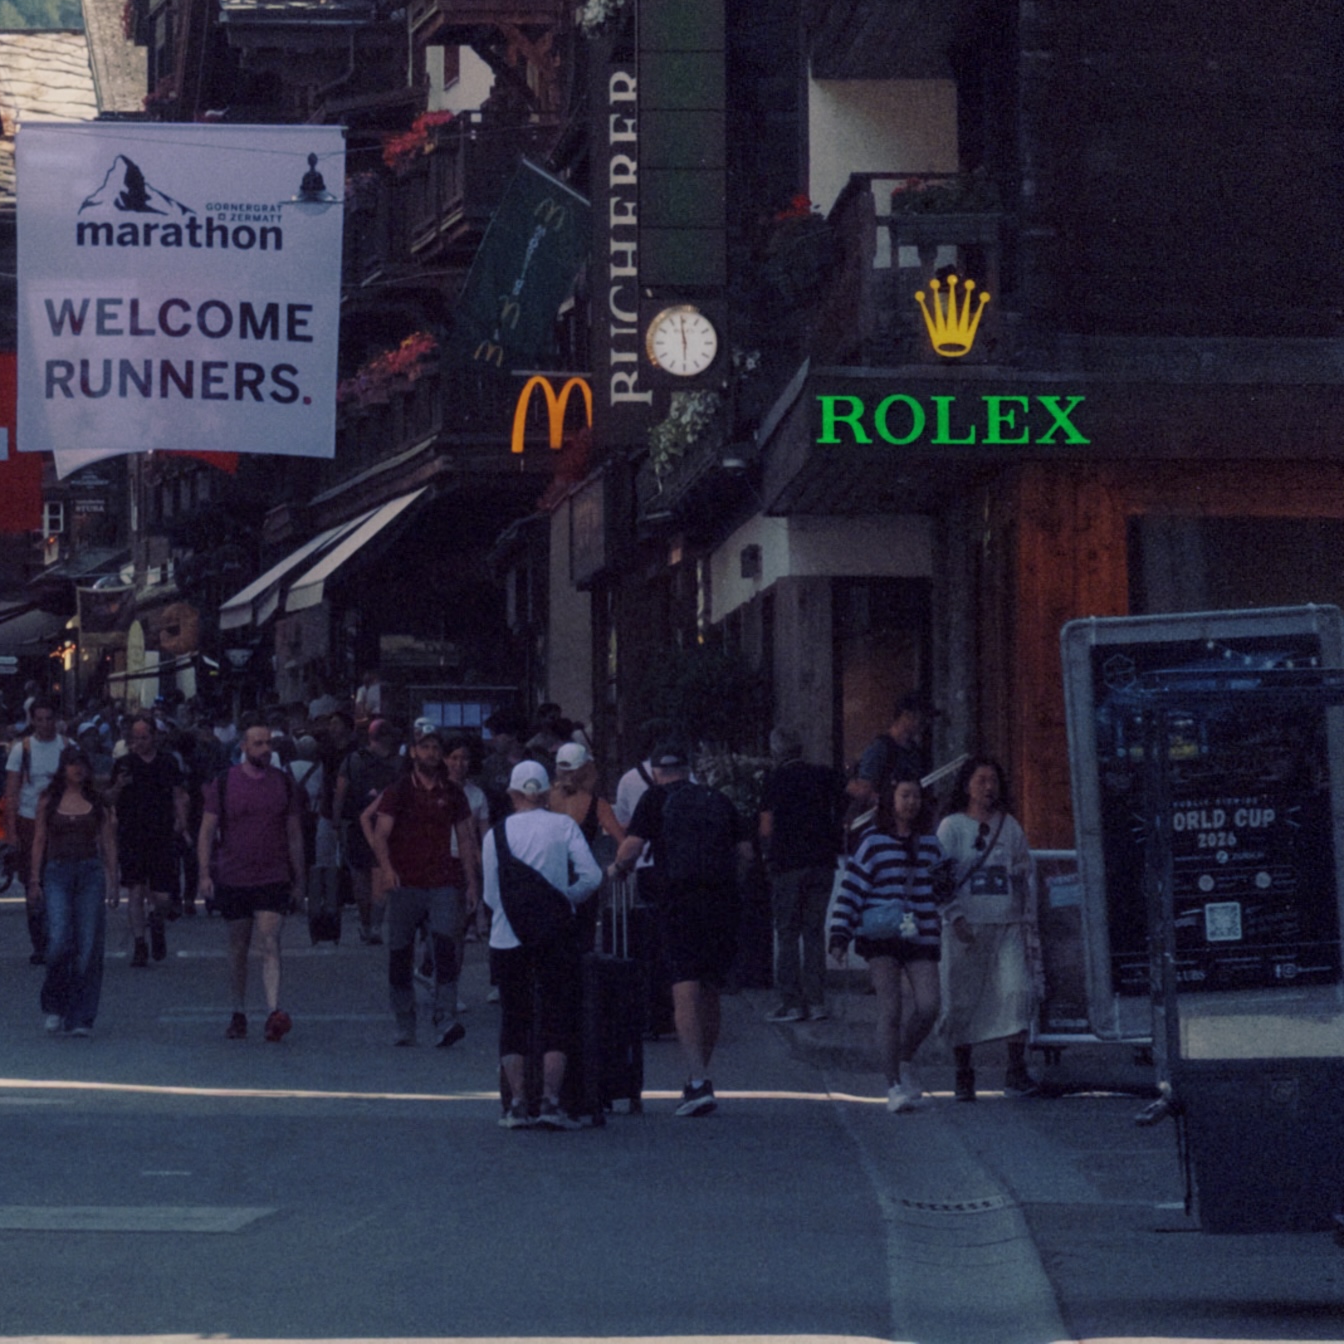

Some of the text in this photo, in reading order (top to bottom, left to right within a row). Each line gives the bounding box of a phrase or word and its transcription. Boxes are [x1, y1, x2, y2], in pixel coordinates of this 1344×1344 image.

[206, 202, 283, 213] GORNERGRAT
[230, 213, 283, 223] ZERMATT
[76, 216, 284, 251] marathon
[44, 298, 314, 343] WELCOME
[45, 359, 312, 405] RUNNERS.
[815, 393, 1092, 446] ROLEX
[1173, 808, 1275, 832] ORLD CUP
[1198, 831, 1237, 848] 2026
